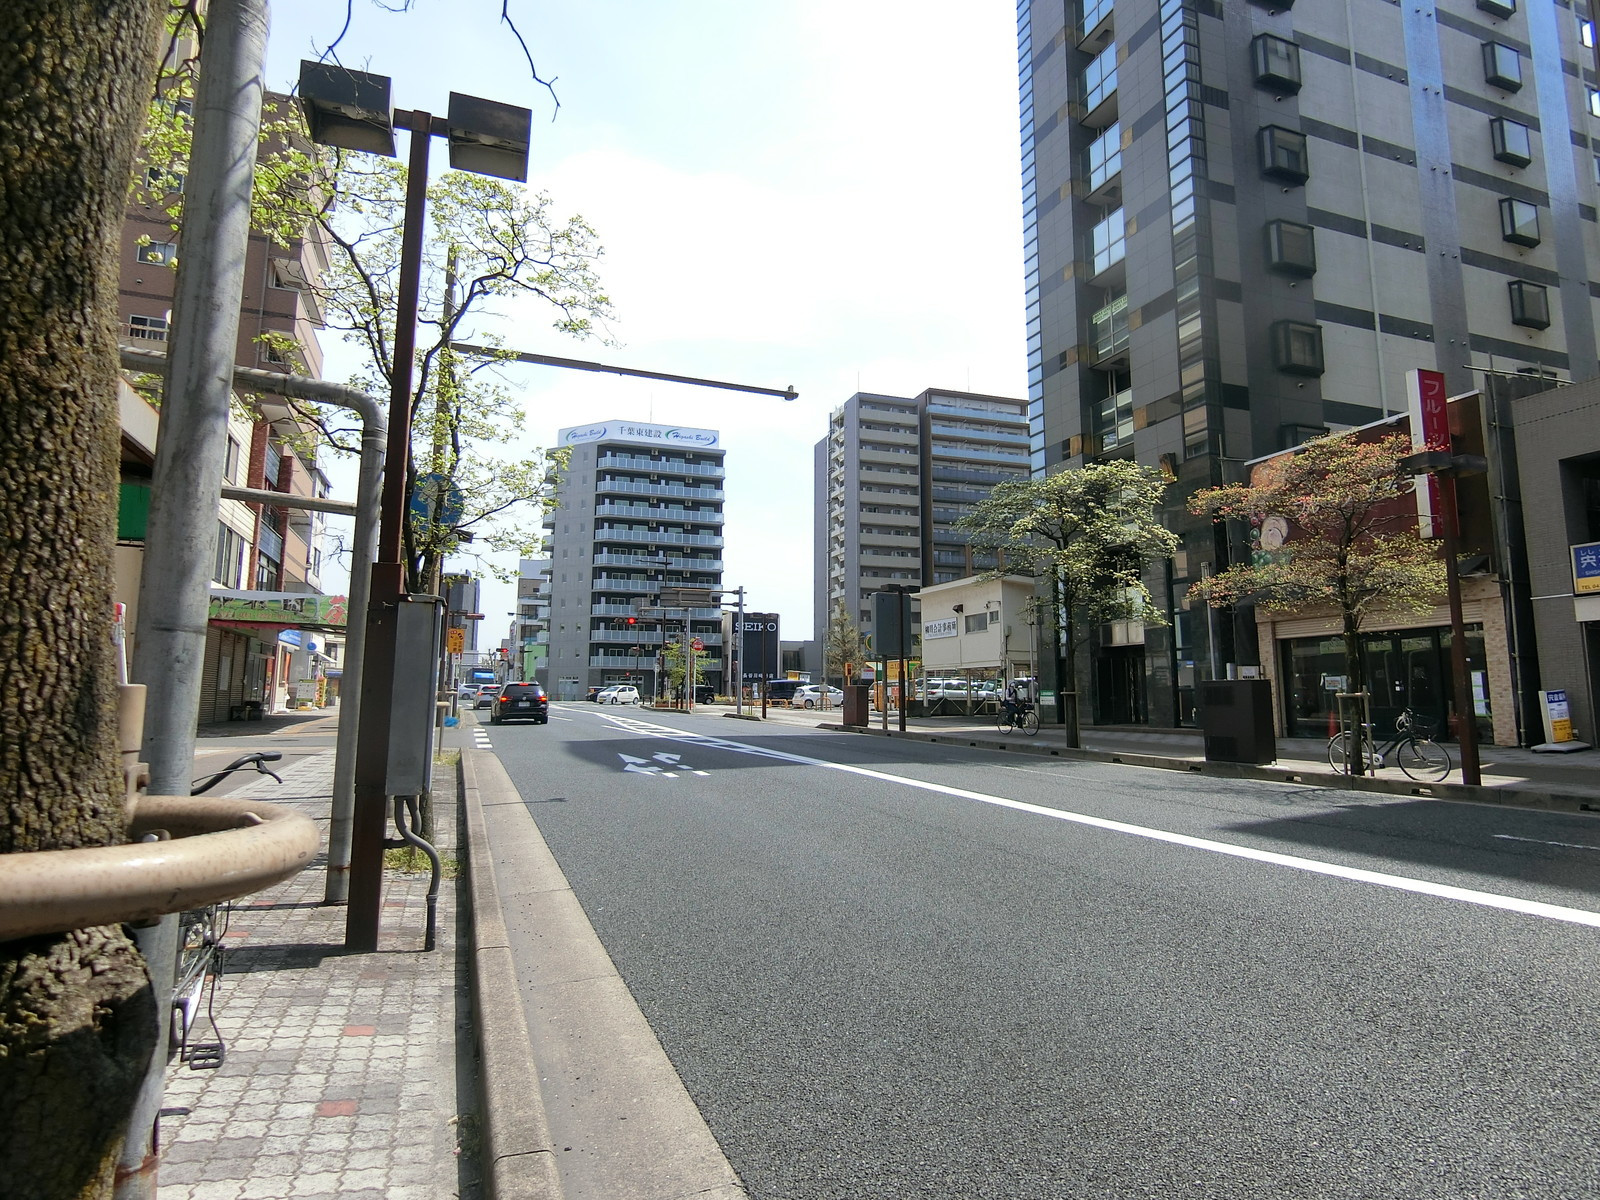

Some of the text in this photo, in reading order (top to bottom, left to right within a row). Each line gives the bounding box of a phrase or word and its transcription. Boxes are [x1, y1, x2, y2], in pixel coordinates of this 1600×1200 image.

[1424, 379, 1446, 449] フルーツ
[618, 426, 662, 439] 千葉東建設
[695, 434, 711, 442] Build
[1580, 555, 1600, 568] 宍
